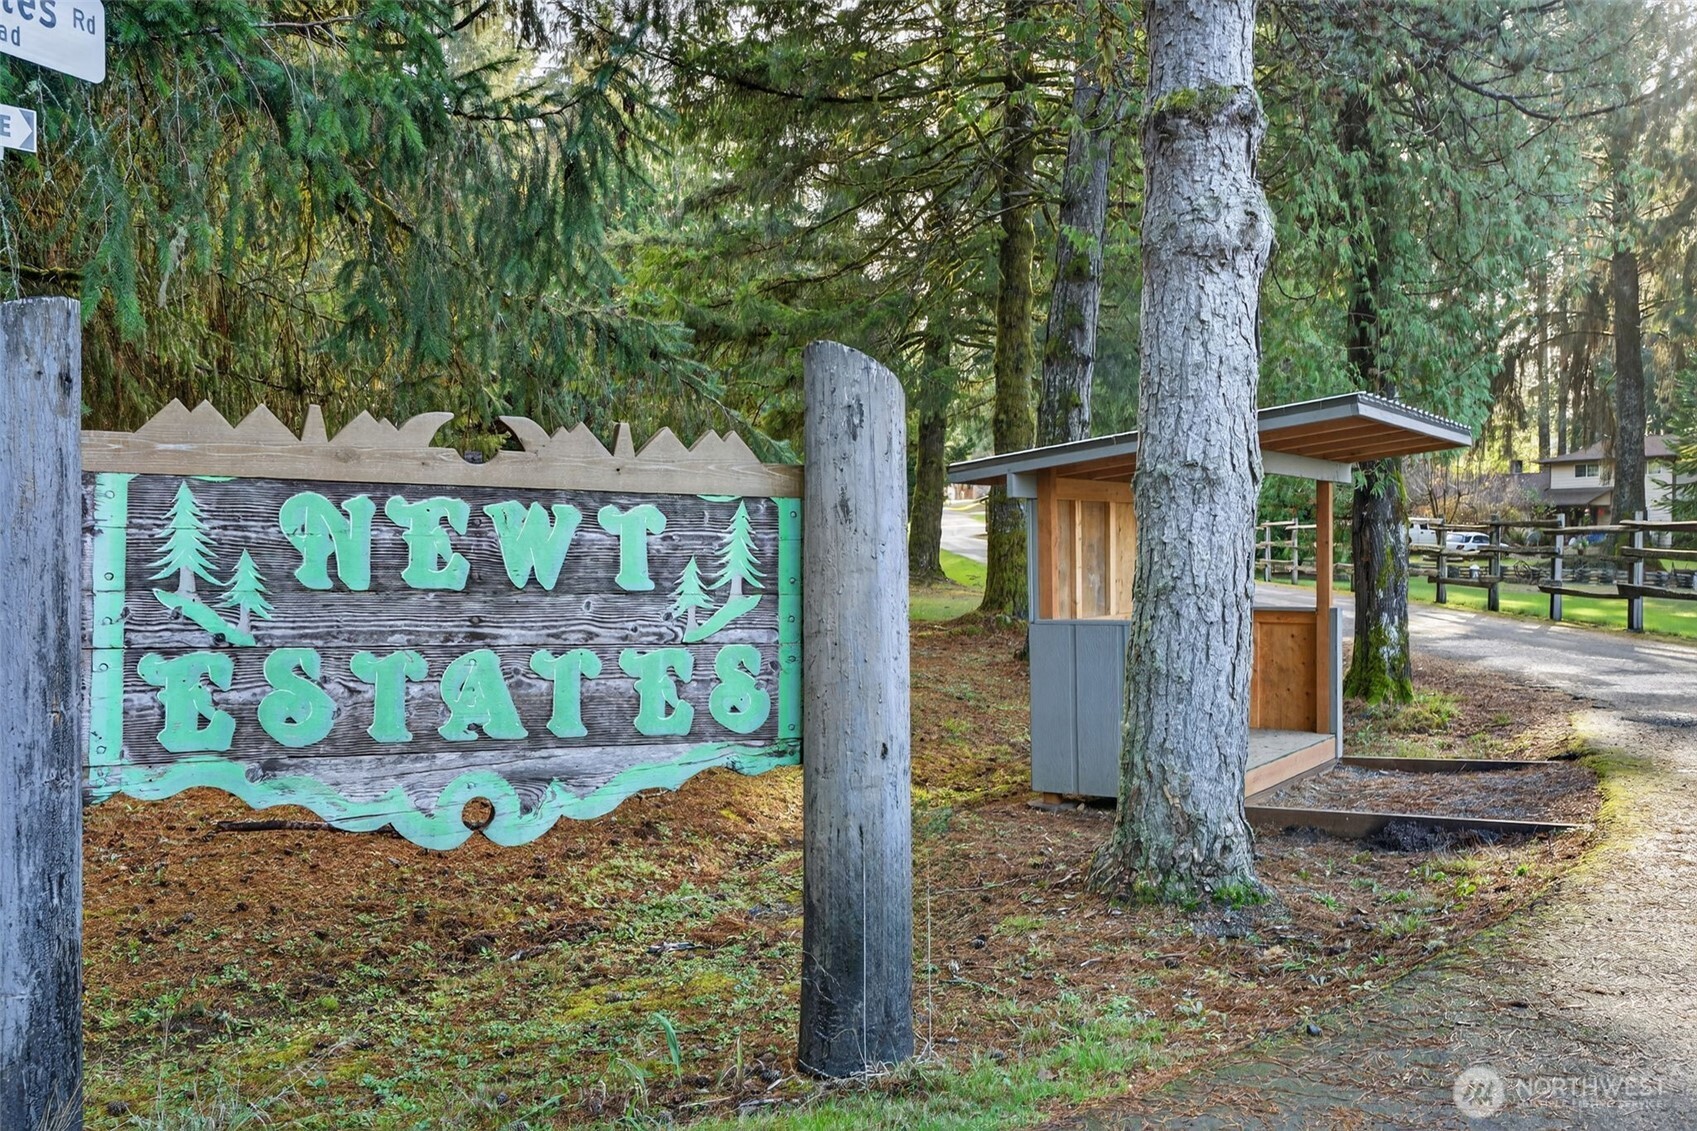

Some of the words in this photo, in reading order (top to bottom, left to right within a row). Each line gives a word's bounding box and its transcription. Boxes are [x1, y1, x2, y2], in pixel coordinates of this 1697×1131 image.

[73, 7, 95, 35] Rd
[279, 491, 667, 592] NEWT
[136, 645, 771, 753] ESTATES
